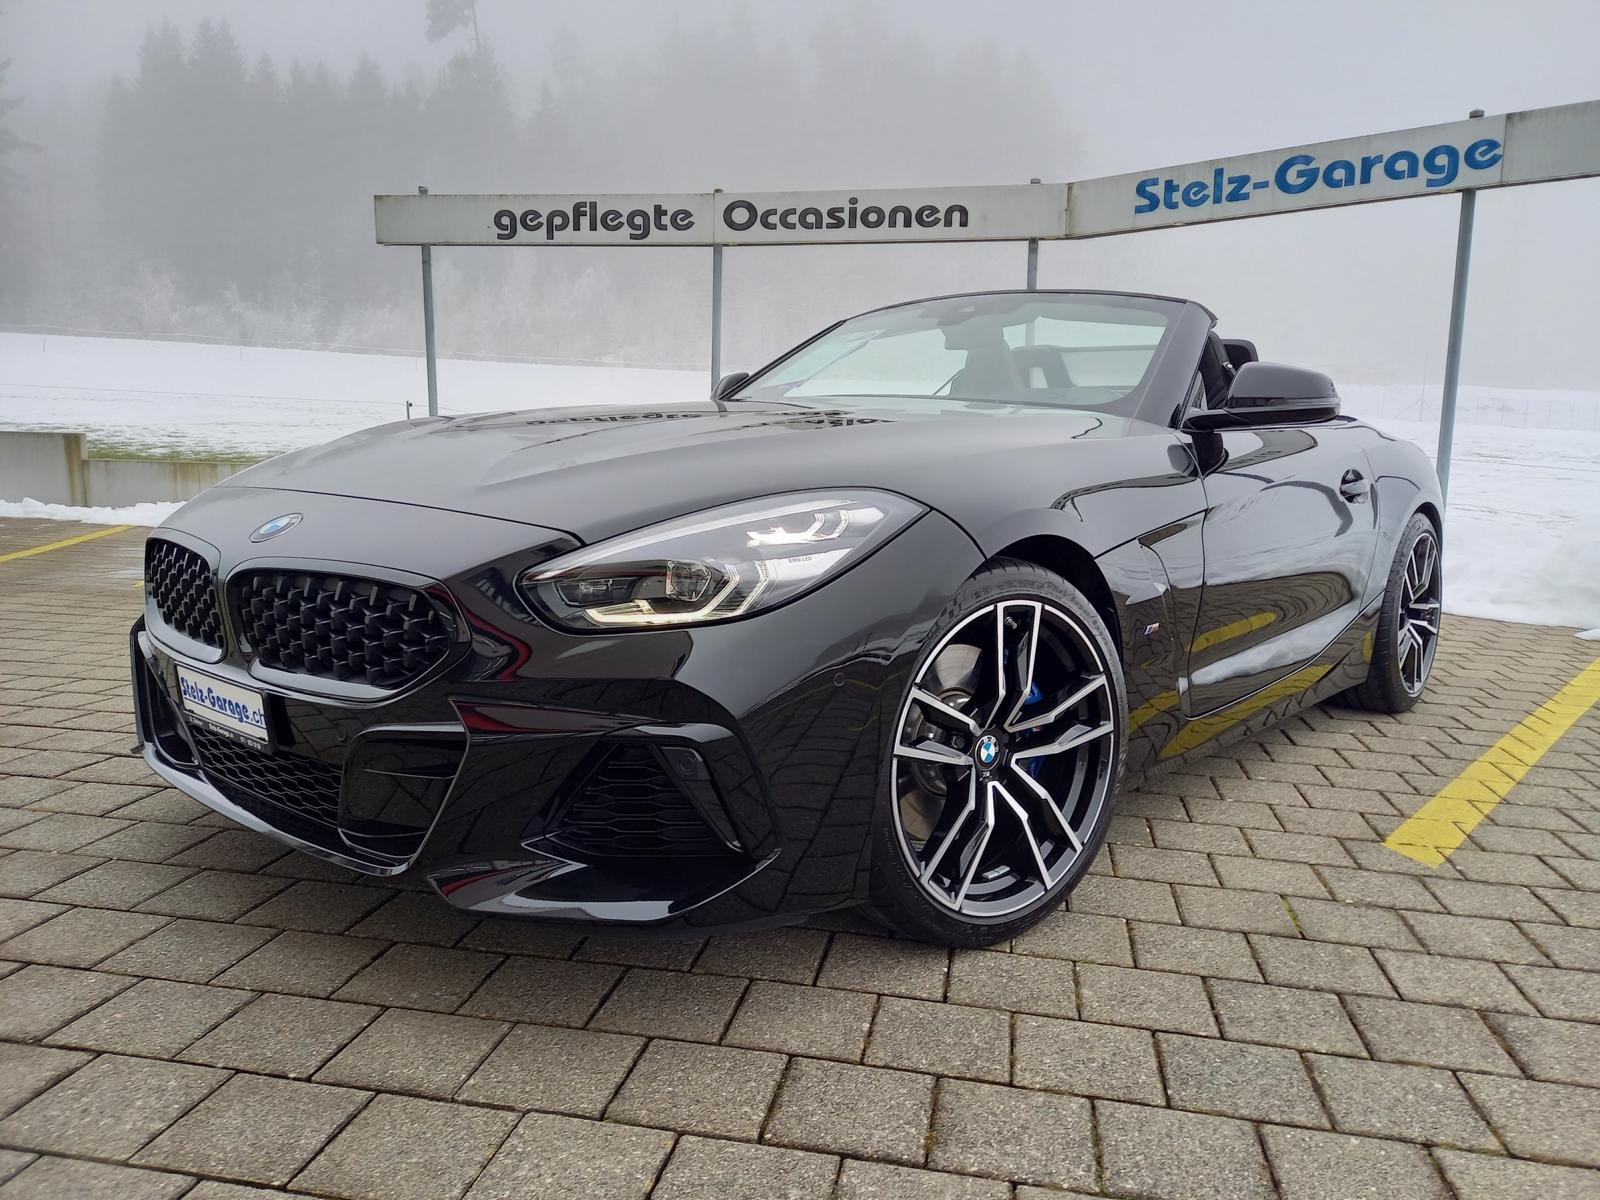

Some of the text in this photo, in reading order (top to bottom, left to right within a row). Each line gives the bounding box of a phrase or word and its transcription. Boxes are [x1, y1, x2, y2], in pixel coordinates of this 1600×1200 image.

[1134, 138, 1503, 214] Stelz-Garage
[493, 197, 969, 240] gepflegte Occasionen
